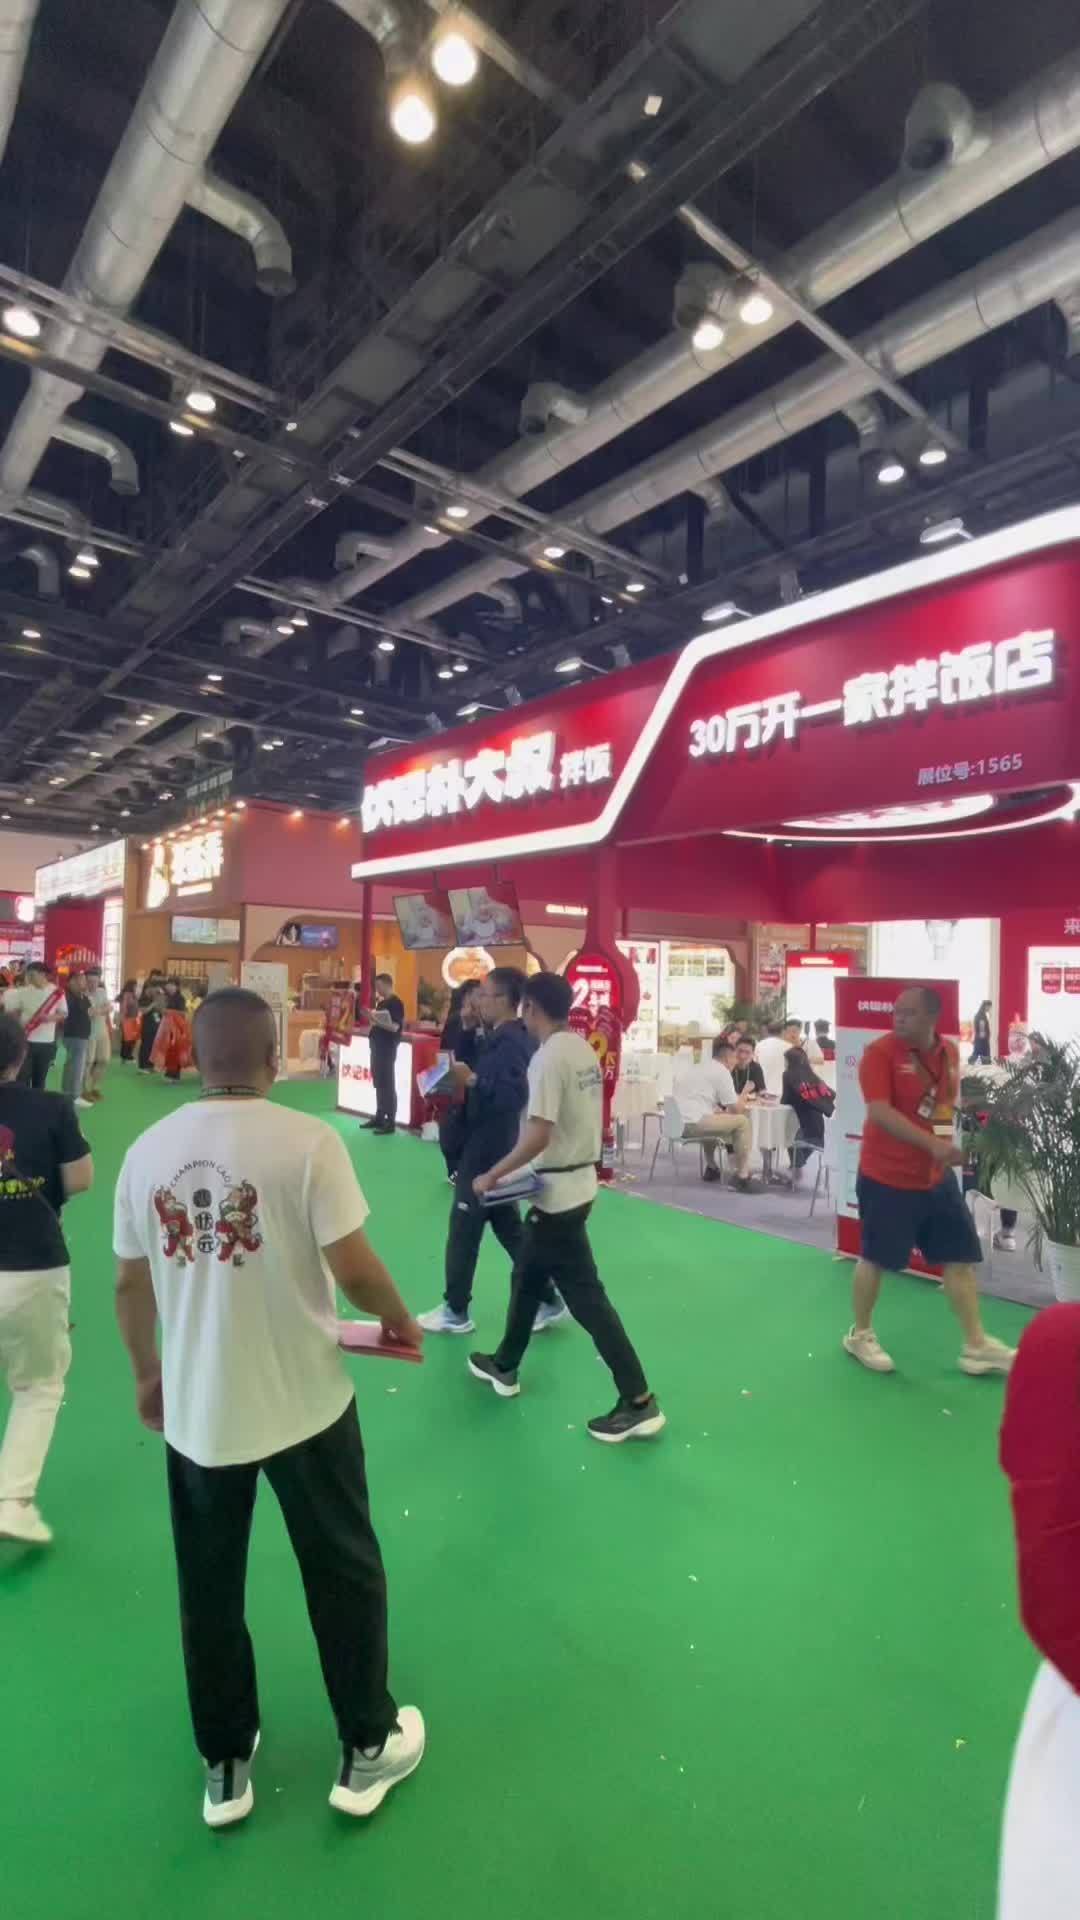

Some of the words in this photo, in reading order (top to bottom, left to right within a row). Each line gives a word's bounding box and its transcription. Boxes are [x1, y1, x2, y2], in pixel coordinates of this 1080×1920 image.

[688, 629, 1054, 758] 30万开一家拌饭店
[917, 753, 1023, 786] 展位号:1565
[170, 1159, 216, 1188] CHAMPION
